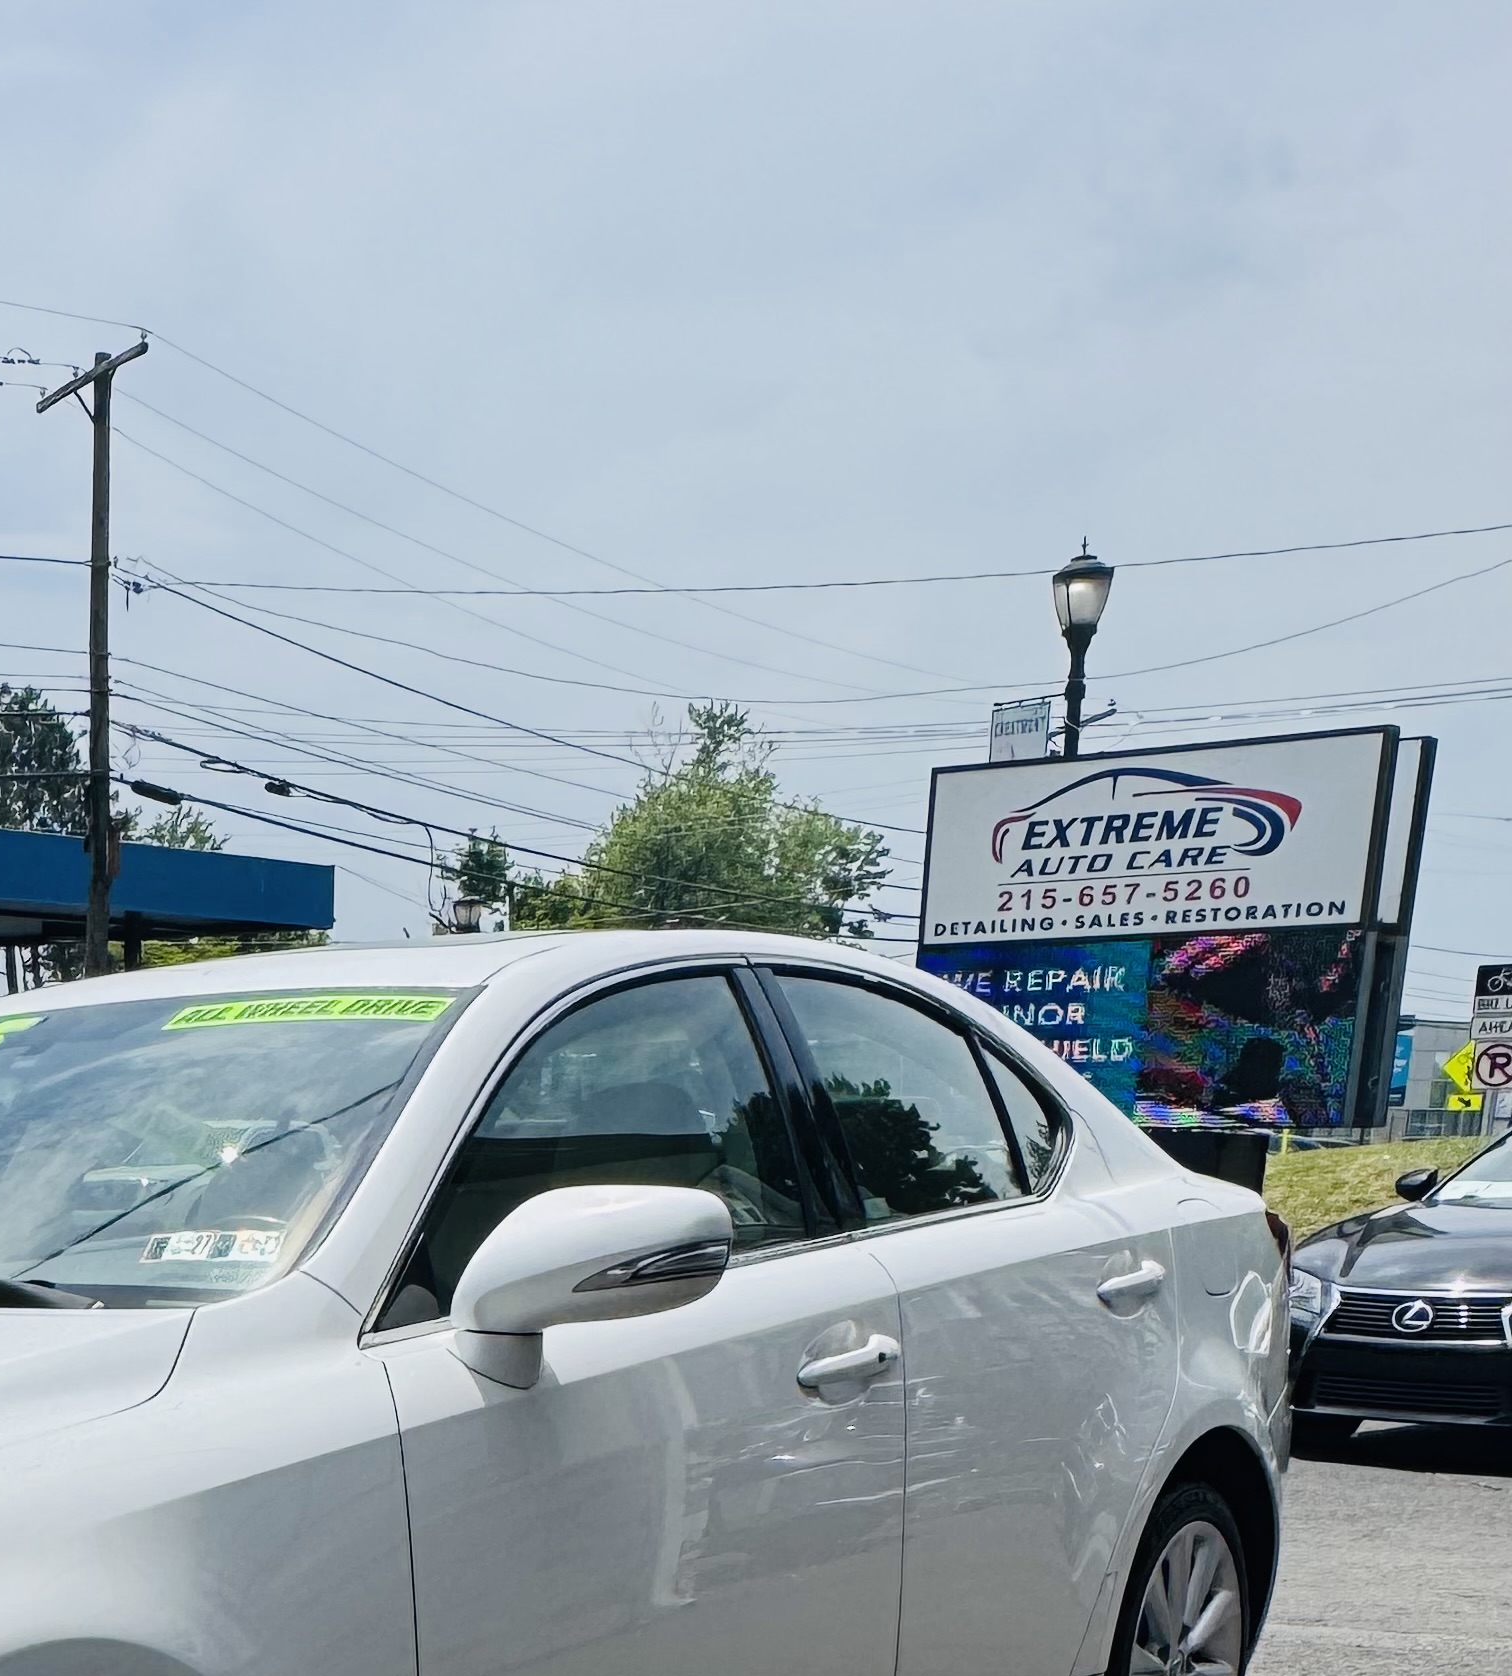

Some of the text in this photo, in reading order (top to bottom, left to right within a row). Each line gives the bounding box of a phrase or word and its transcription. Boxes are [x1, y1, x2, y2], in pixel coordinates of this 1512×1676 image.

[1021, 806, 1224, 851] EXTREME
[1010, 845, 1231, 878] AUTO CARE
[997, 875, 1251, 912] 215-657-5260
[934, 900, 1346, 936] DETAILING SALES RESTORATION
[1003, 965, 1126, 993] REPAIR
[170, 999, 446, 1026] ALL WHEEL DRIVE
